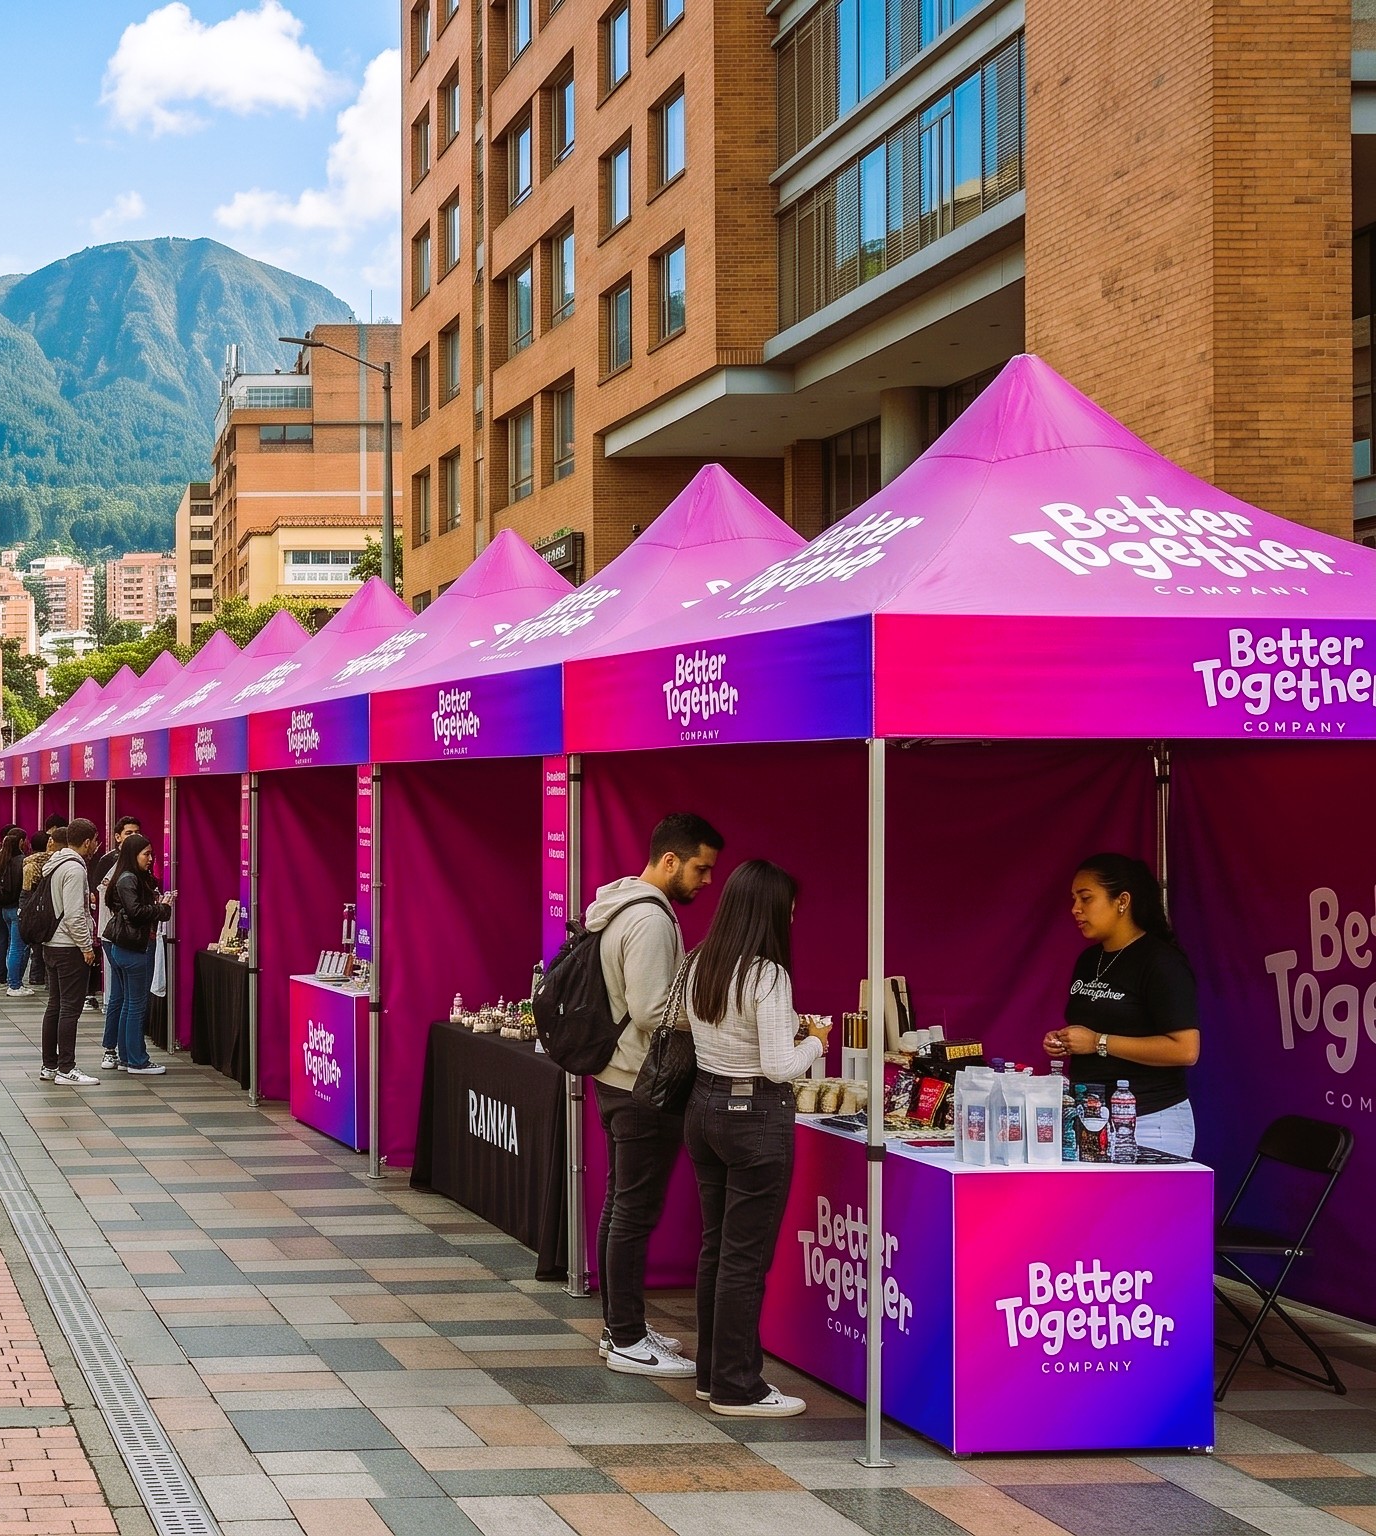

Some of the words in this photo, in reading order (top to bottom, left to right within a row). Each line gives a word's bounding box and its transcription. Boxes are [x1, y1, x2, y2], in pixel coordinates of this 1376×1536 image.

[1039, 495, 1254, 540] Better
[1008, 530, 1337, 580] Together
[1153, 585, 1311, 596] COMPANY
[675, 649, 727, 687] Better
[1228, 627, 1364, 668] Better
[438, 688, 472, 716] Better
[662, 680, 739, 727] Together
[431, 711, 480, 747] Together
[680, 729, 720, 741] COMPANY
[1243, 720, 1347, 733] COMPANY
[1309, 884, 1376, 972] Be
[817, 1195, 899, 1269] Bettr
[797, 1230, 913, 1332] Togeter
[1028, 1258, 1154, 1306] Better
[827, 1317, 885, 1349] COMPA
[995, 1296, 1175, 1356] Together
[1041, 1360, 1132, 1374] COMPANY
